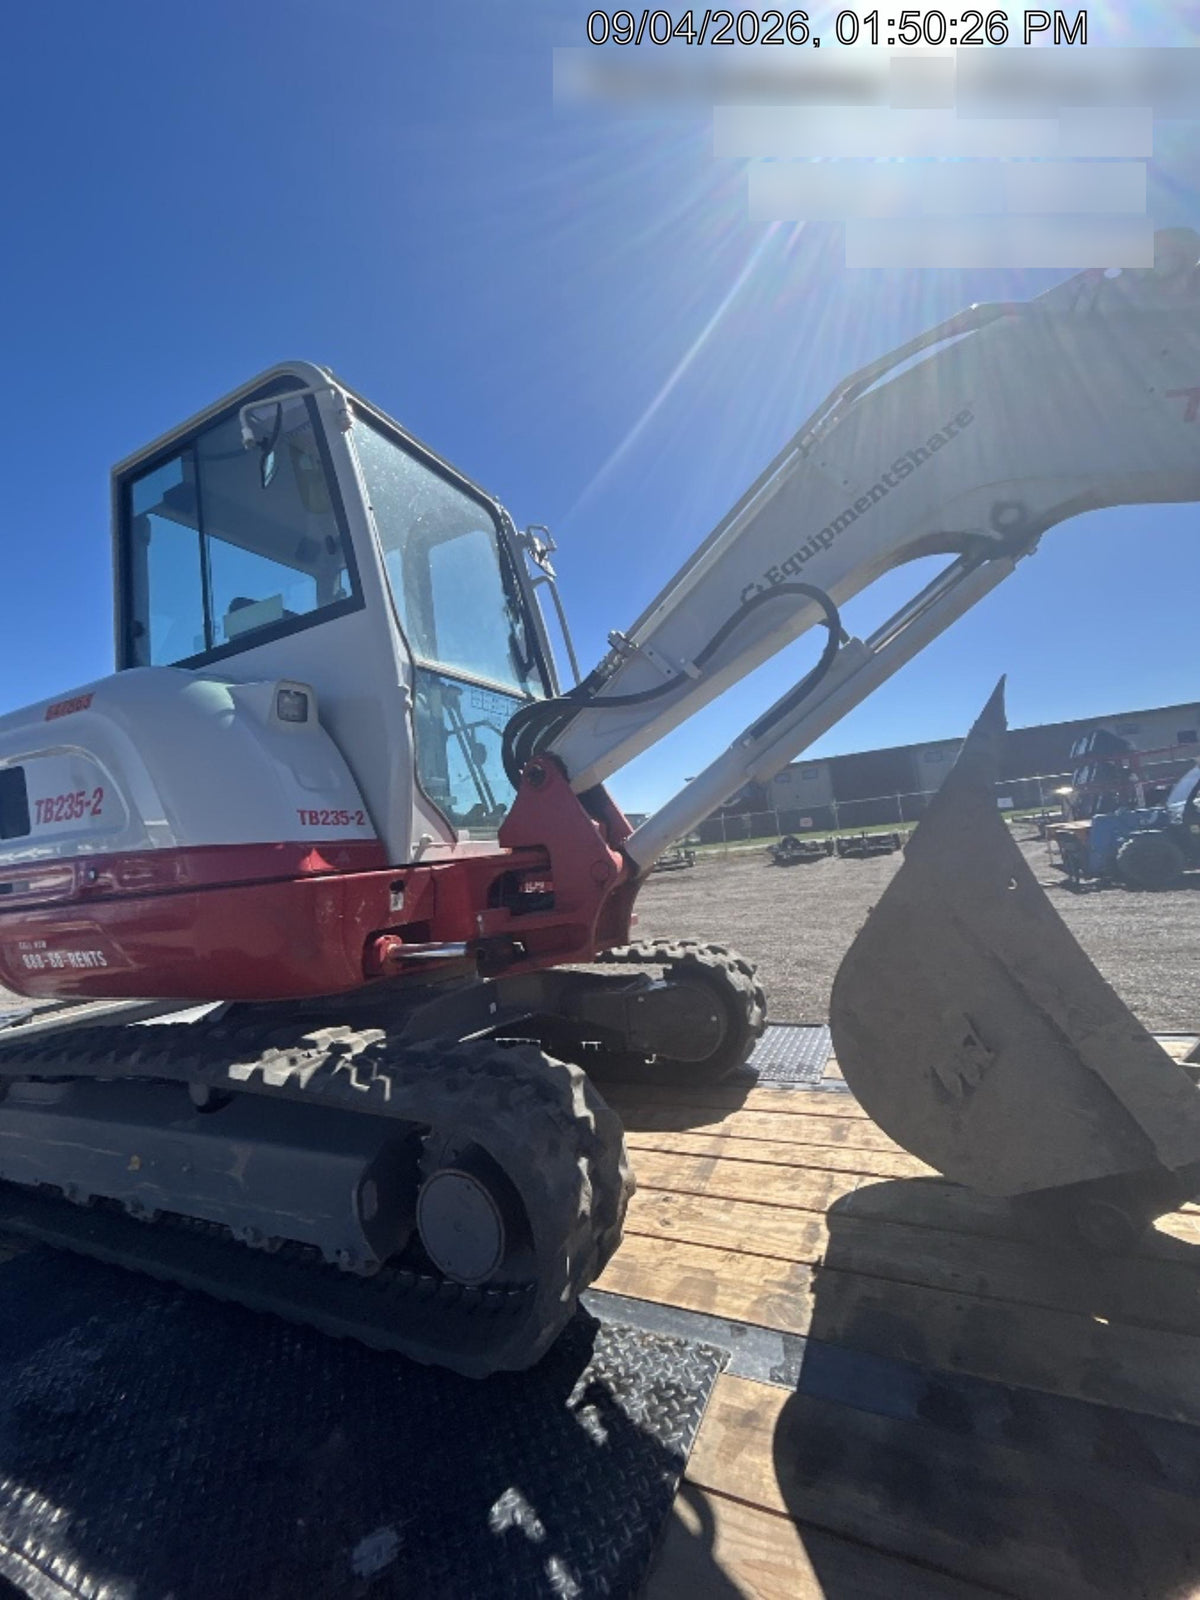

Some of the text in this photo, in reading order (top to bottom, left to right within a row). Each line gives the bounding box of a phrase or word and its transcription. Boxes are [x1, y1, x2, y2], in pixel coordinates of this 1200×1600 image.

[763, 408, 975, 585] EquipmentShare
[34, 787, 104, 825] TB235-2
[296, 809, 366, 826] TB235-2
